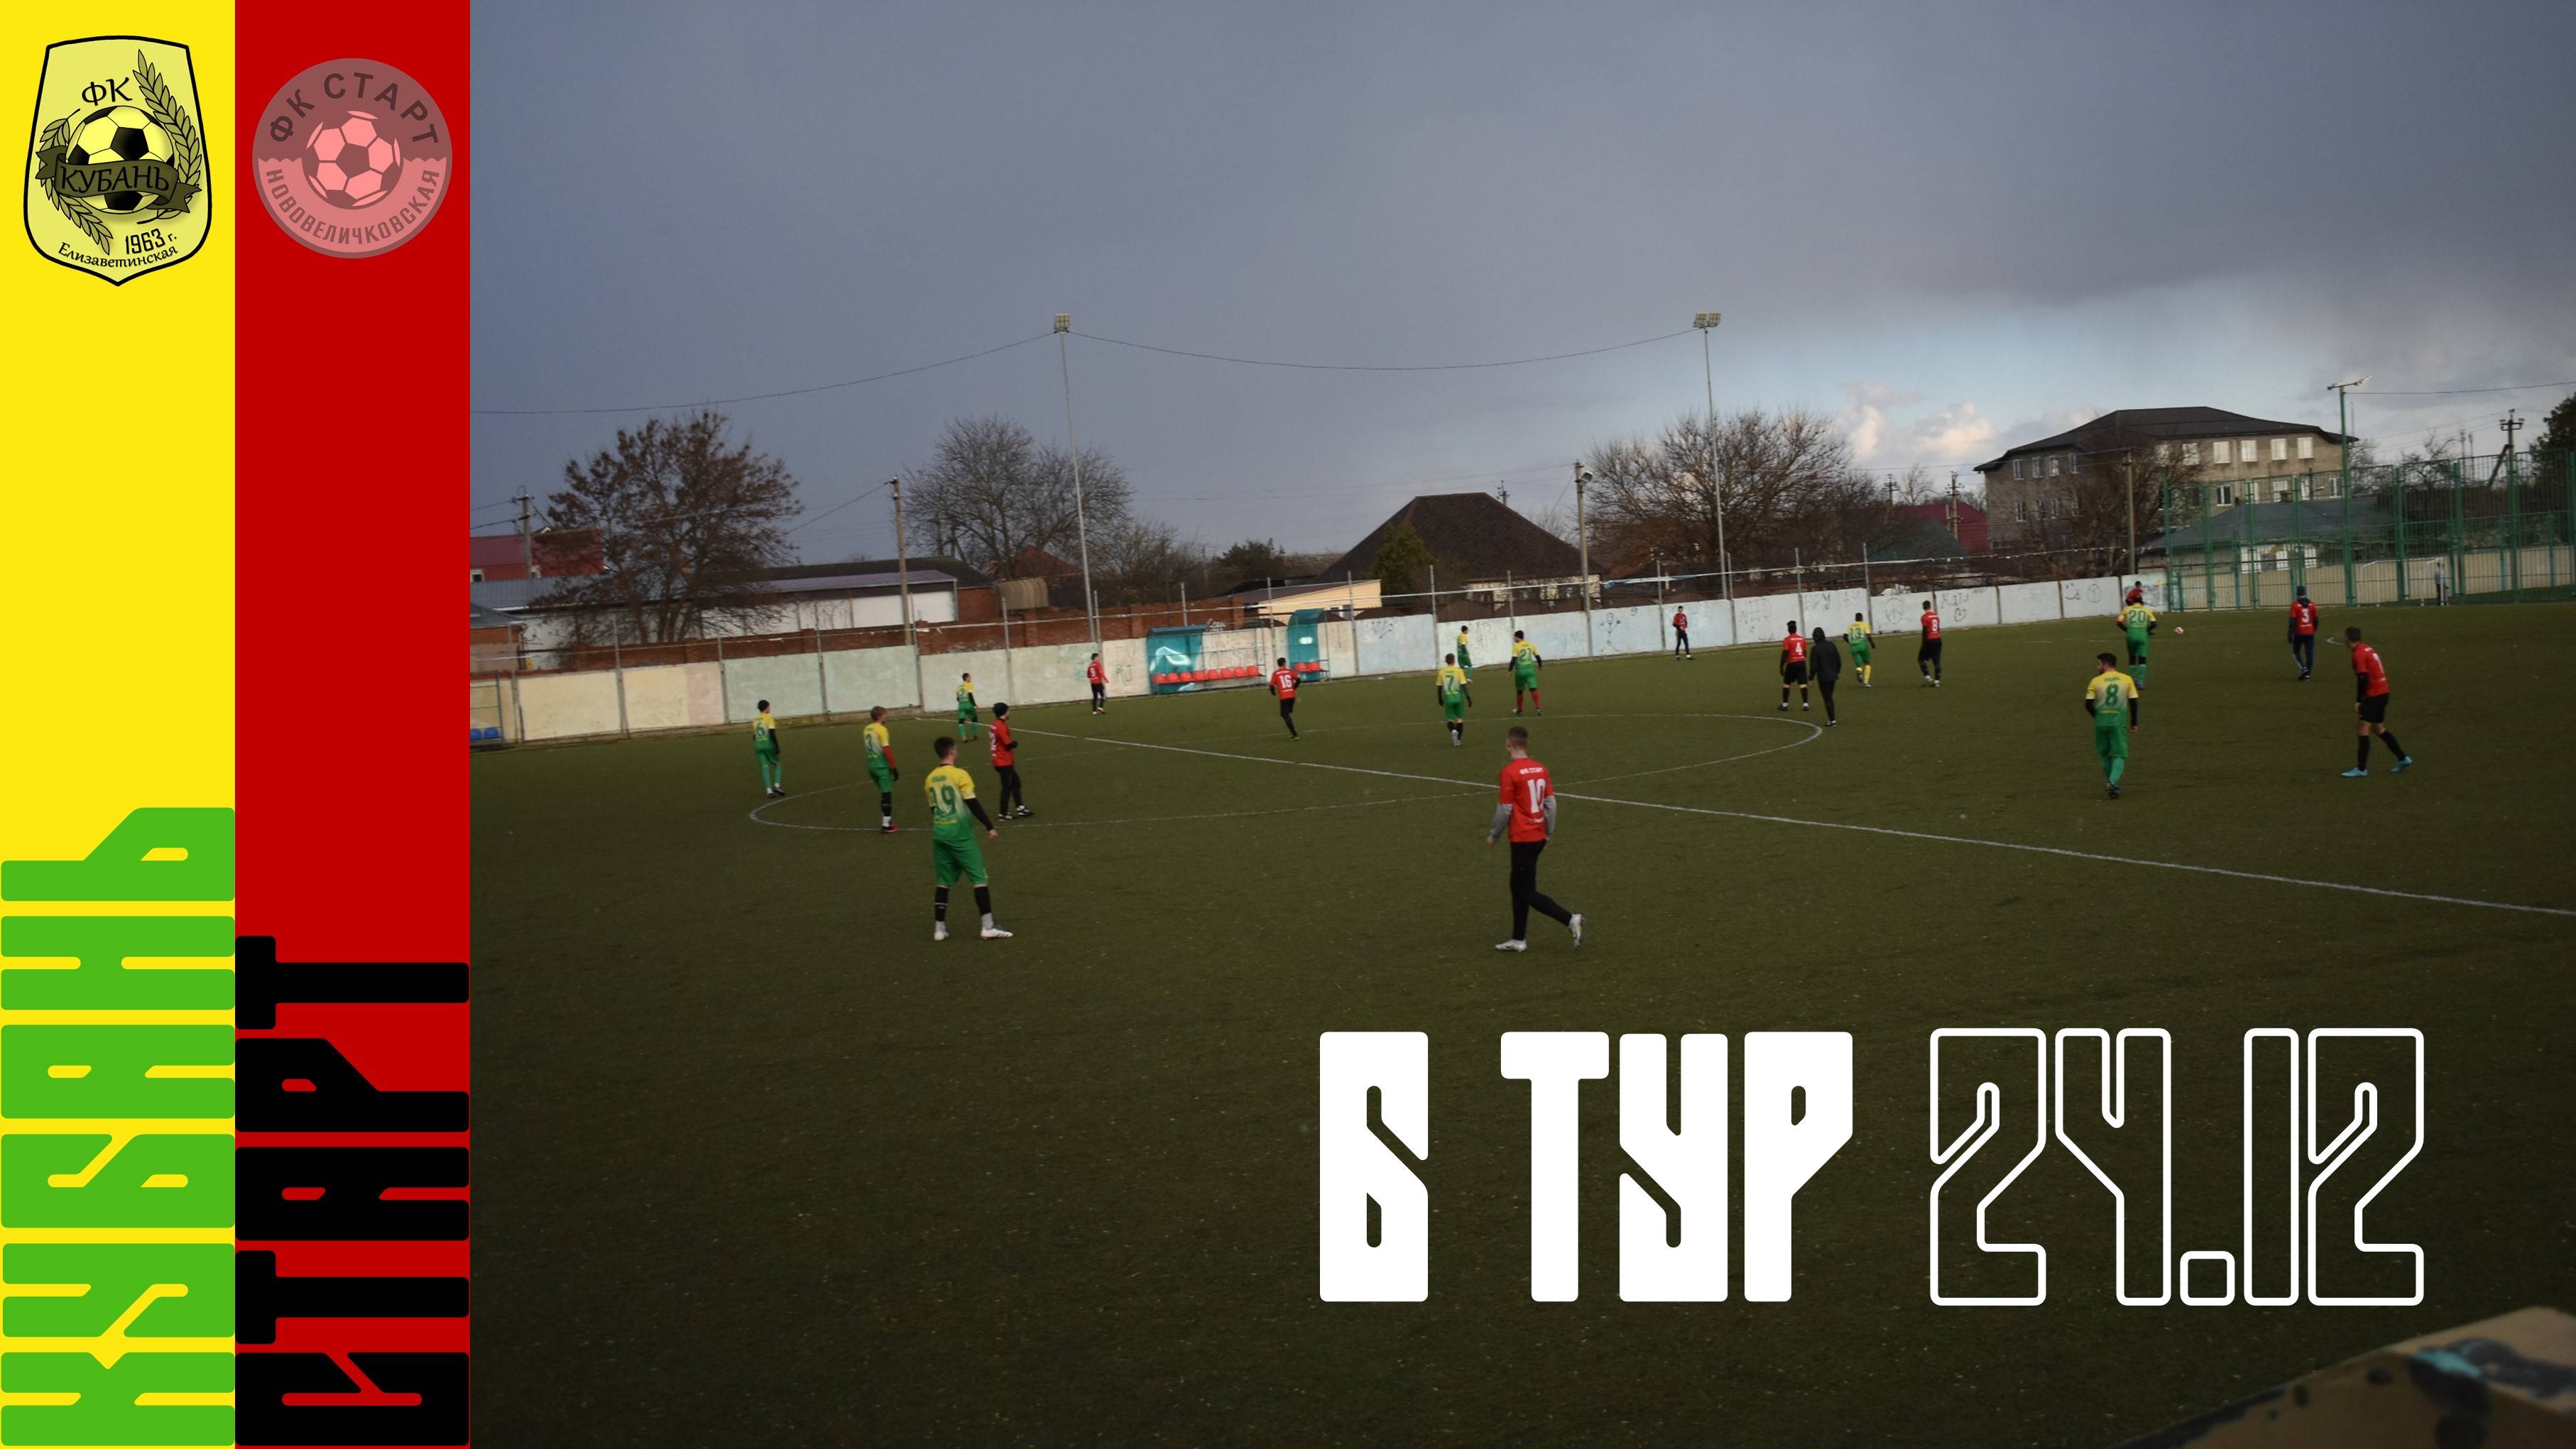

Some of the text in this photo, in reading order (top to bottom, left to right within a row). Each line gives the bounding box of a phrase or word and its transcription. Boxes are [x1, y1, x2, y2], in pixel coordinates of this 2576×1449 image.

[2129, 610, 2146, 625] 20
[2301, 608, 2310, 623] 3
[1931, 618, 1938, 632] 8
[1519, 647, 1532, 662] 21
[1795, 642, 1803, 655] 4
[1279, 674, 1292, 689] 16
[1445, 674, 1455, 691] 7
[2105, 684, 2119, 706] 8
[755, 721, 765, 738] 6
[1527, 777, 1546, 814] 10
